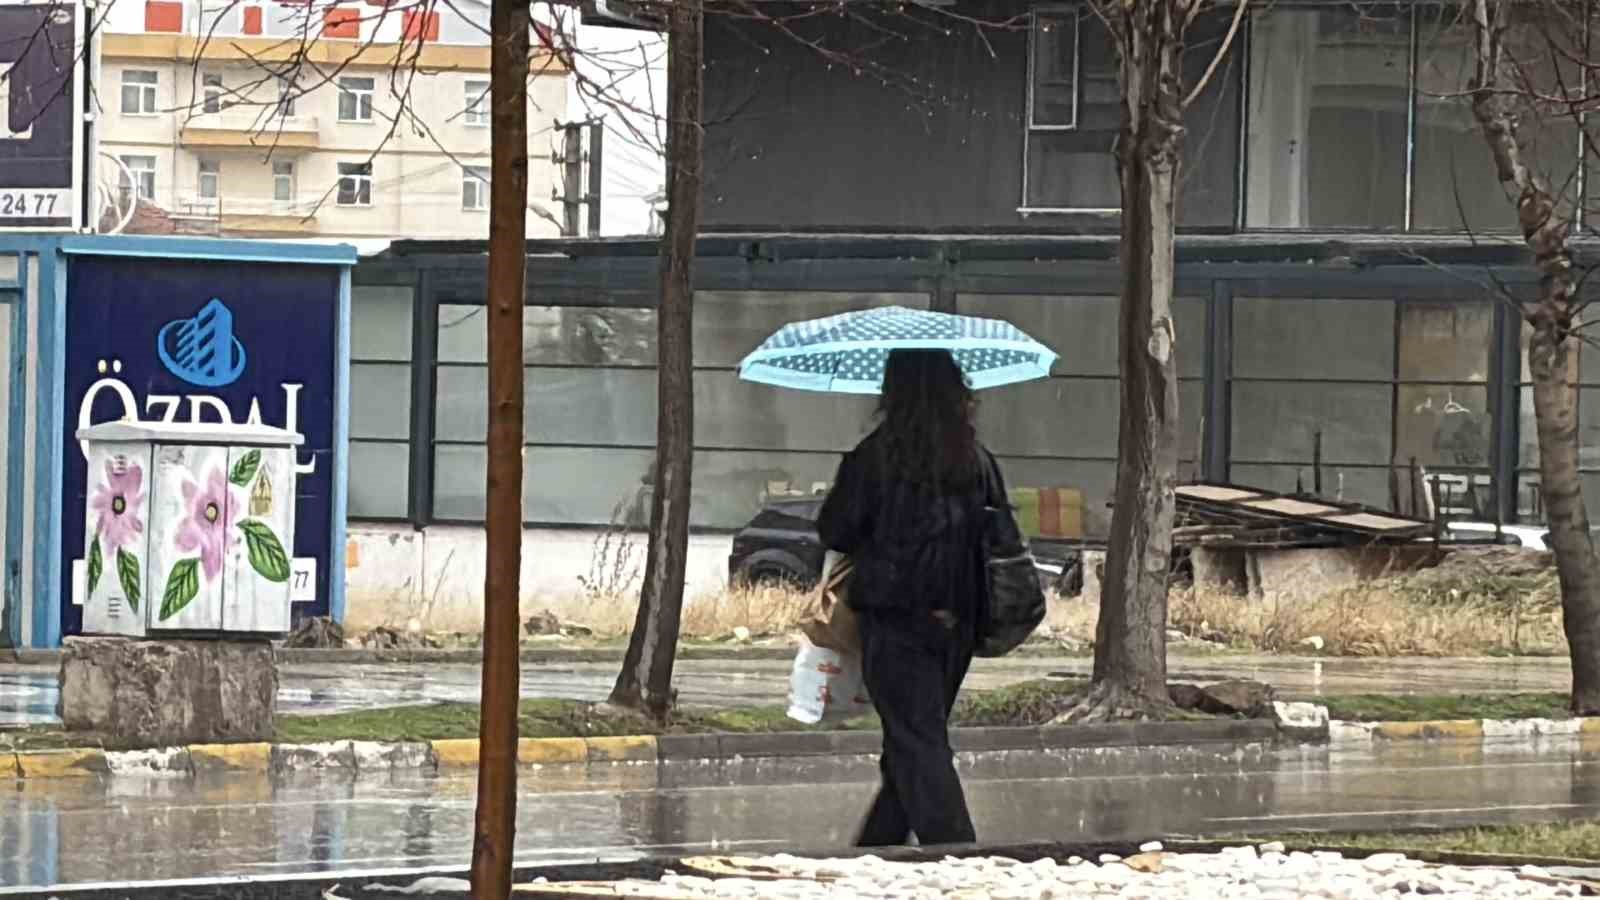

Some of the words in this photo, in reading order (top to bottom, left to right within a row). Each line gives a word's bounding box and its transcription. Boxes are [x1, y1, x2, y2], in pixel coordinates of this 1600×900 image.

[2, 193, 26, 214] 24
[34, 193, 58, 215] 77
[294, 570, 309, 589] 77
